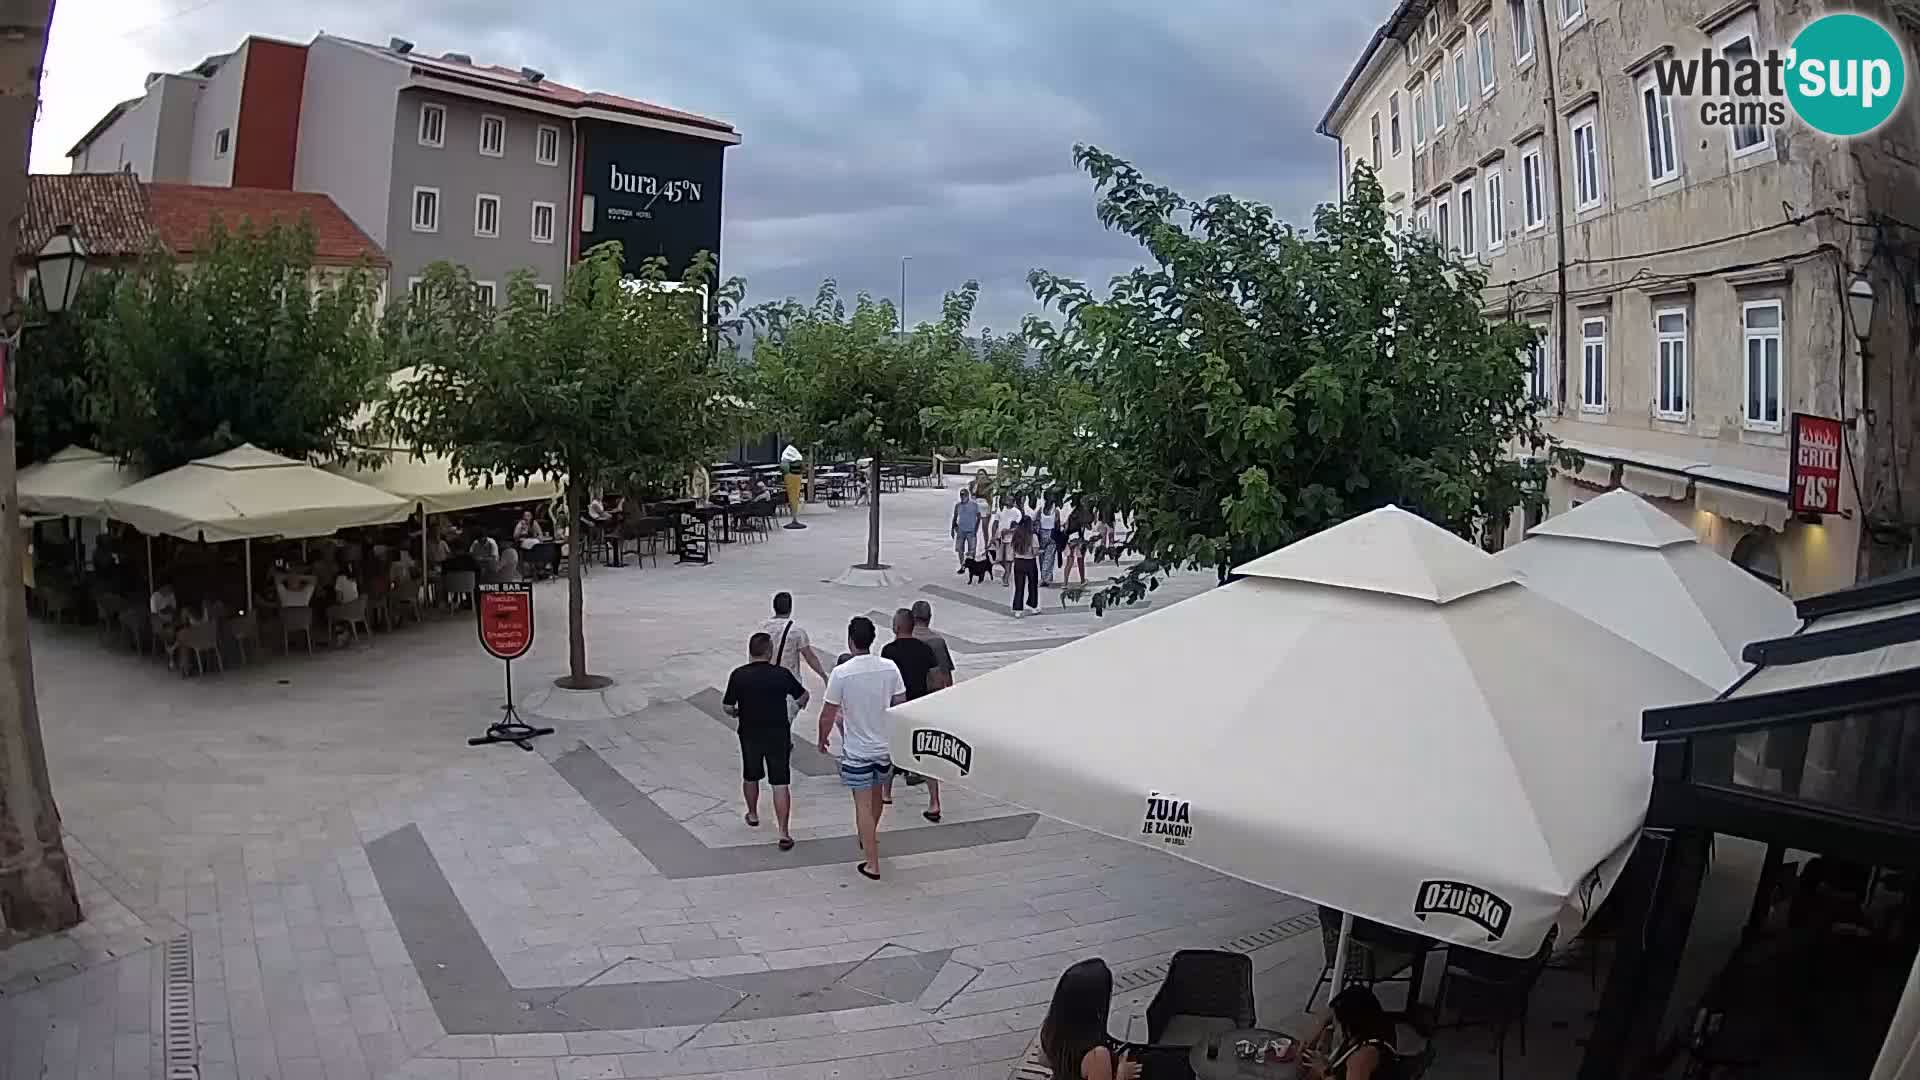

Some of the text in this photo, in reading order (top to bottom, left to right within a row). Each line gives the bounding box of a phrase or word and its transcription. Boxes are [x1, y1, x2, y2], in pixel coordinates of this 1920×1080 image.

[610, 164, 657, 195] bura
[1798, 446, 1838, 470] GRILL
[479, 583, 521, 592] WINE BAR
[916, 731, 967, 765] Ožujsko
[1145, 791, 1190, 824] ŽUJA
[1142, 821, 1193, 839] JE ZAKON!
[1423, 883, 1504, 929] Ožujsko
